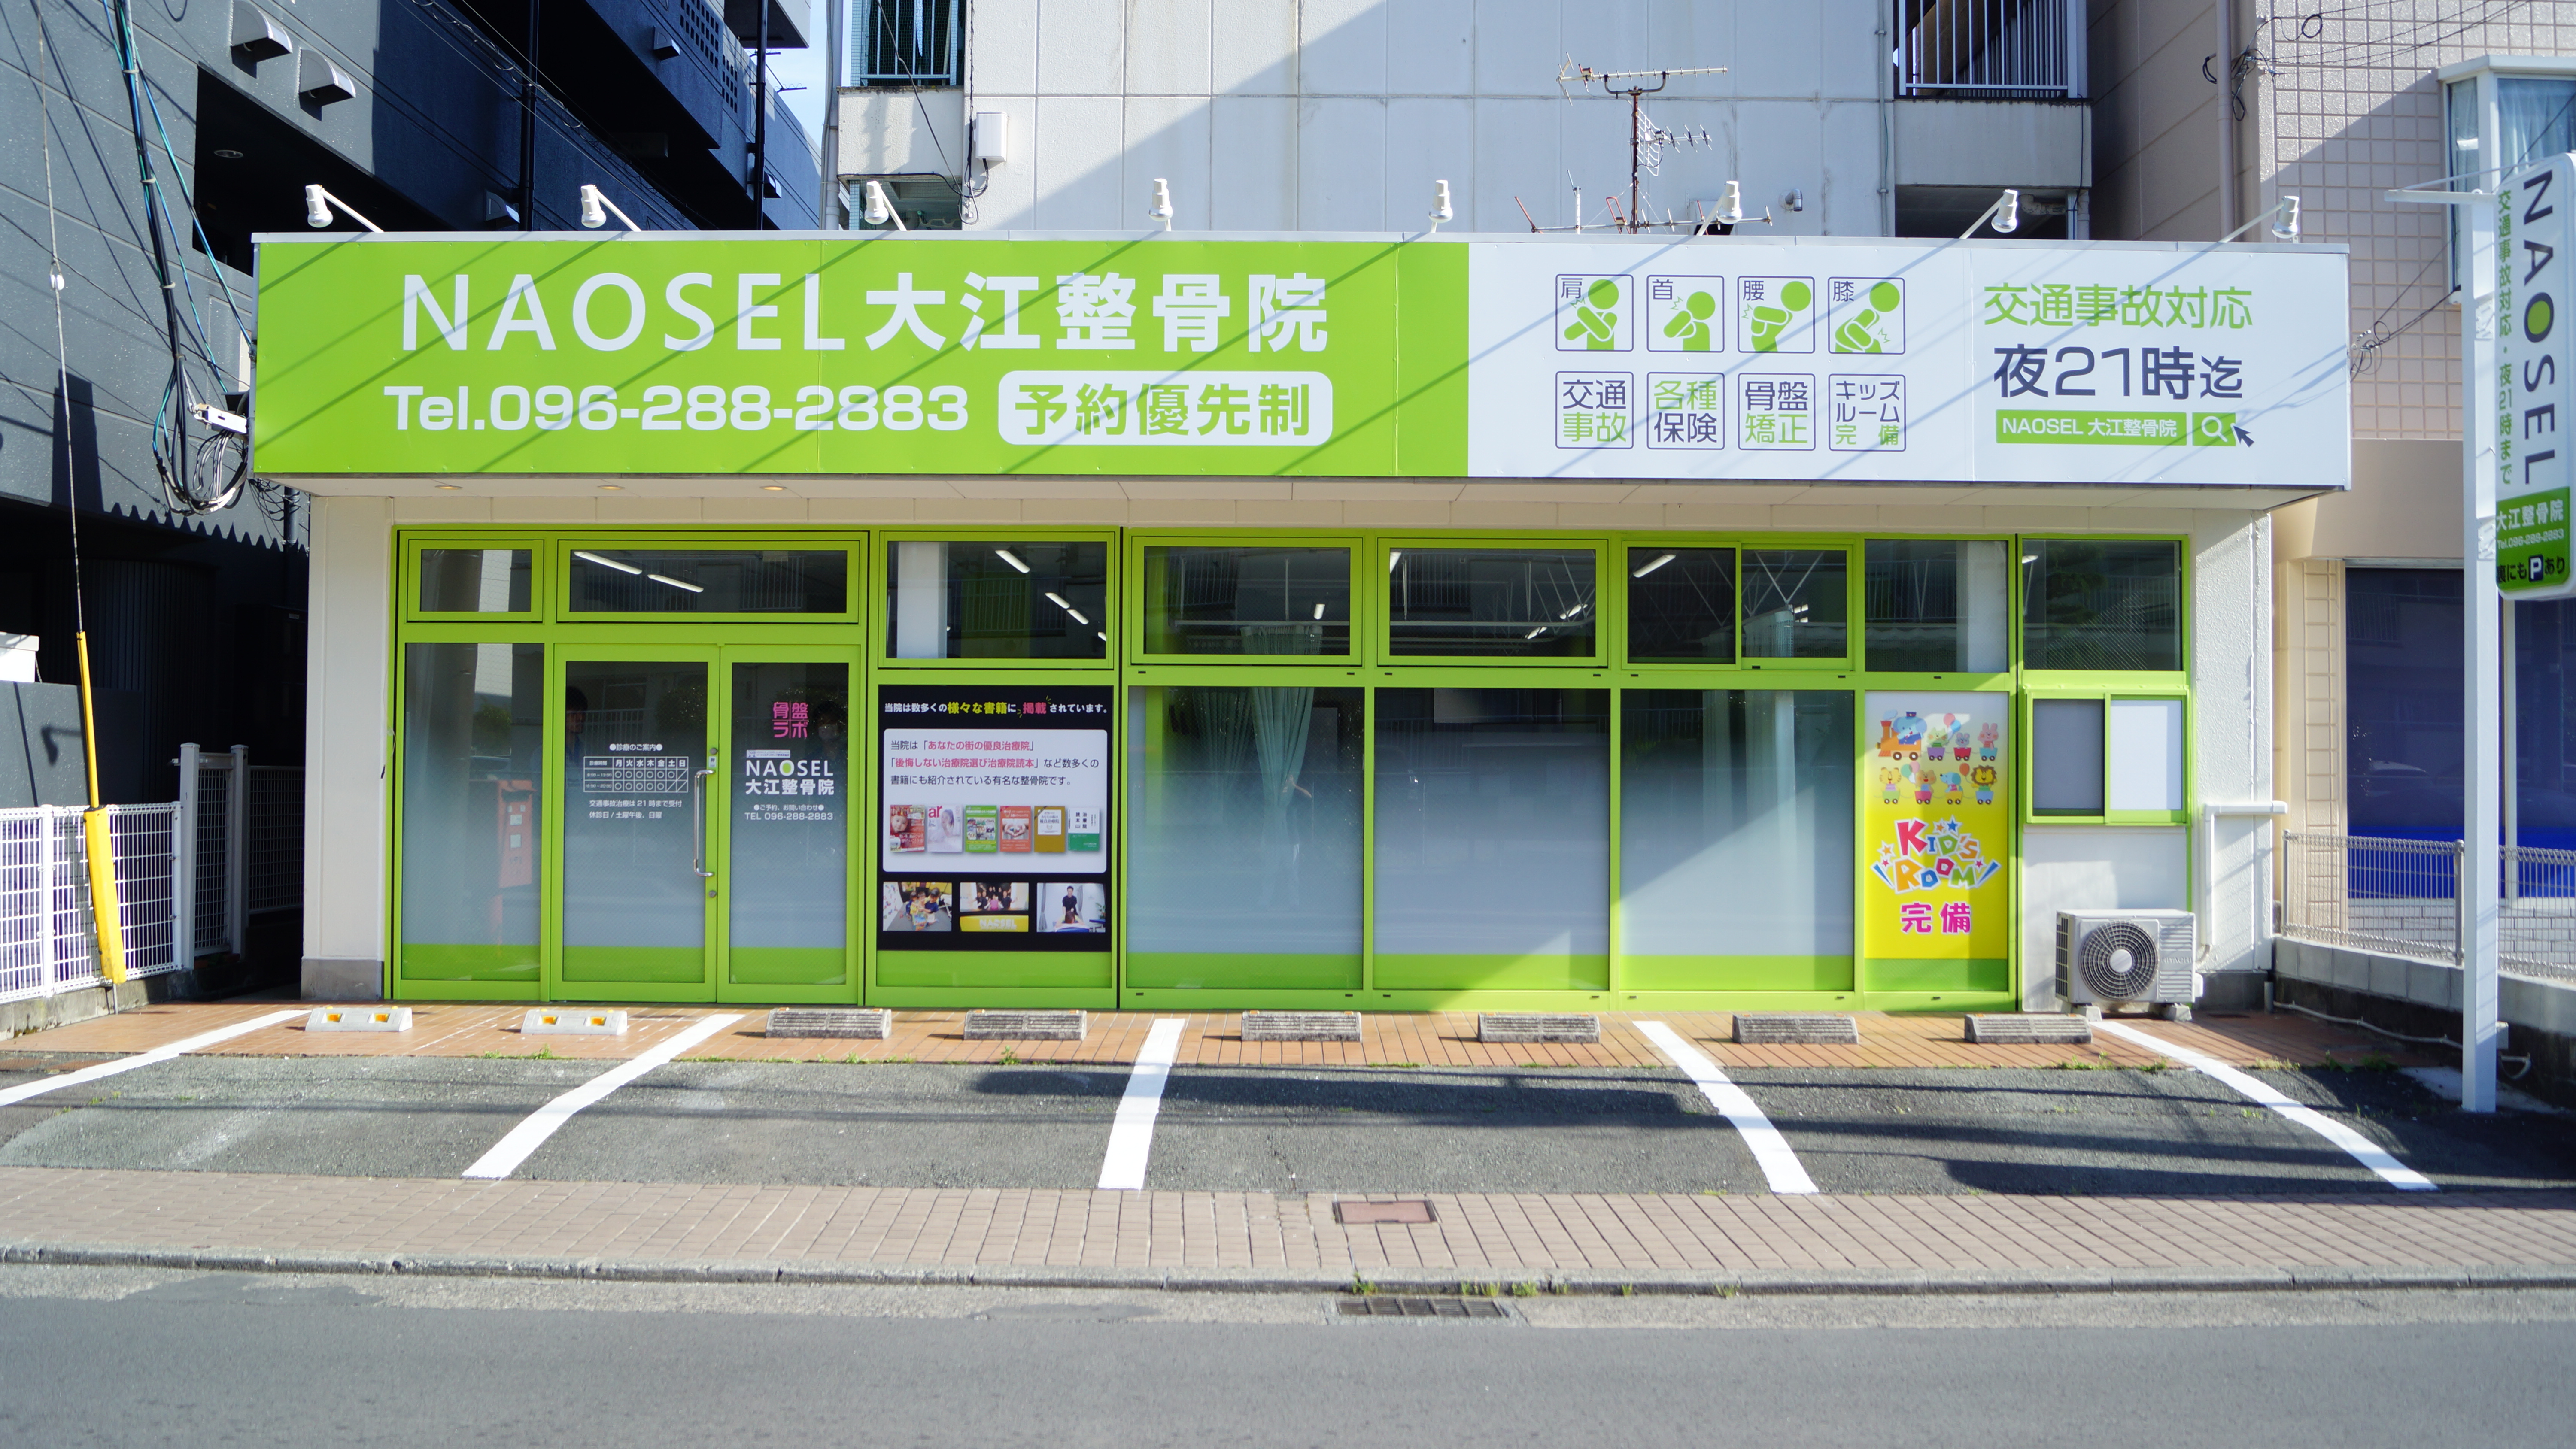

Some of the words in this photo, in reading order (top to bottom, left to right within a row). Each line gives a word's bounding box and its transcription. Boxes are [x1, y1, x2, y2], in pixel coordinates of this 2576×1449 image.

[1561, 279, 1582, 300] 肩
[1652, 279, 1673, 300] 首
[1743, 280, 1764, 301] 腰
[1833, 281, 1854, 302] 膝
[1984, 282, 2252, 329] 交通事故対応
[2524, 170, 2555, 484] NAOSEL
[1993, 343, 2242, 400] 夜21時迄
[1563, 379, 1626, 409] 交通
[1654, 381, 1717, 410] 各種
[1745, 381, 1808, 411] 骨盤
[1836, 380, 1900, 400] キッズ
[384, 385, 968, 431] Tel.096-288-2883
[1015, 384, 1309, 436] 予約優先制
[1836, 403, 1900, 423] ルーム
[1564, 412, 1626, 443] 事故
[1654, 412, 1717, 443] 保険
[1745, 413, 1807, 444] 矯正
[2002, 418, 2084, 435] NAOSEL
[2087, 418, 2178, 438] 大江整骨院
[2497, 499, 2564, 531] 大江整骨院
[773, 702, 808, 718] 骨盤
[774, 722, 808, 738] ラボ
[746, 760, 833, 776] NAOSEL
[746, 779, 834, 795] 大江整骨院
[928, 805, 942, 818] ar
[1900, 902, 1971, 934] 完備
